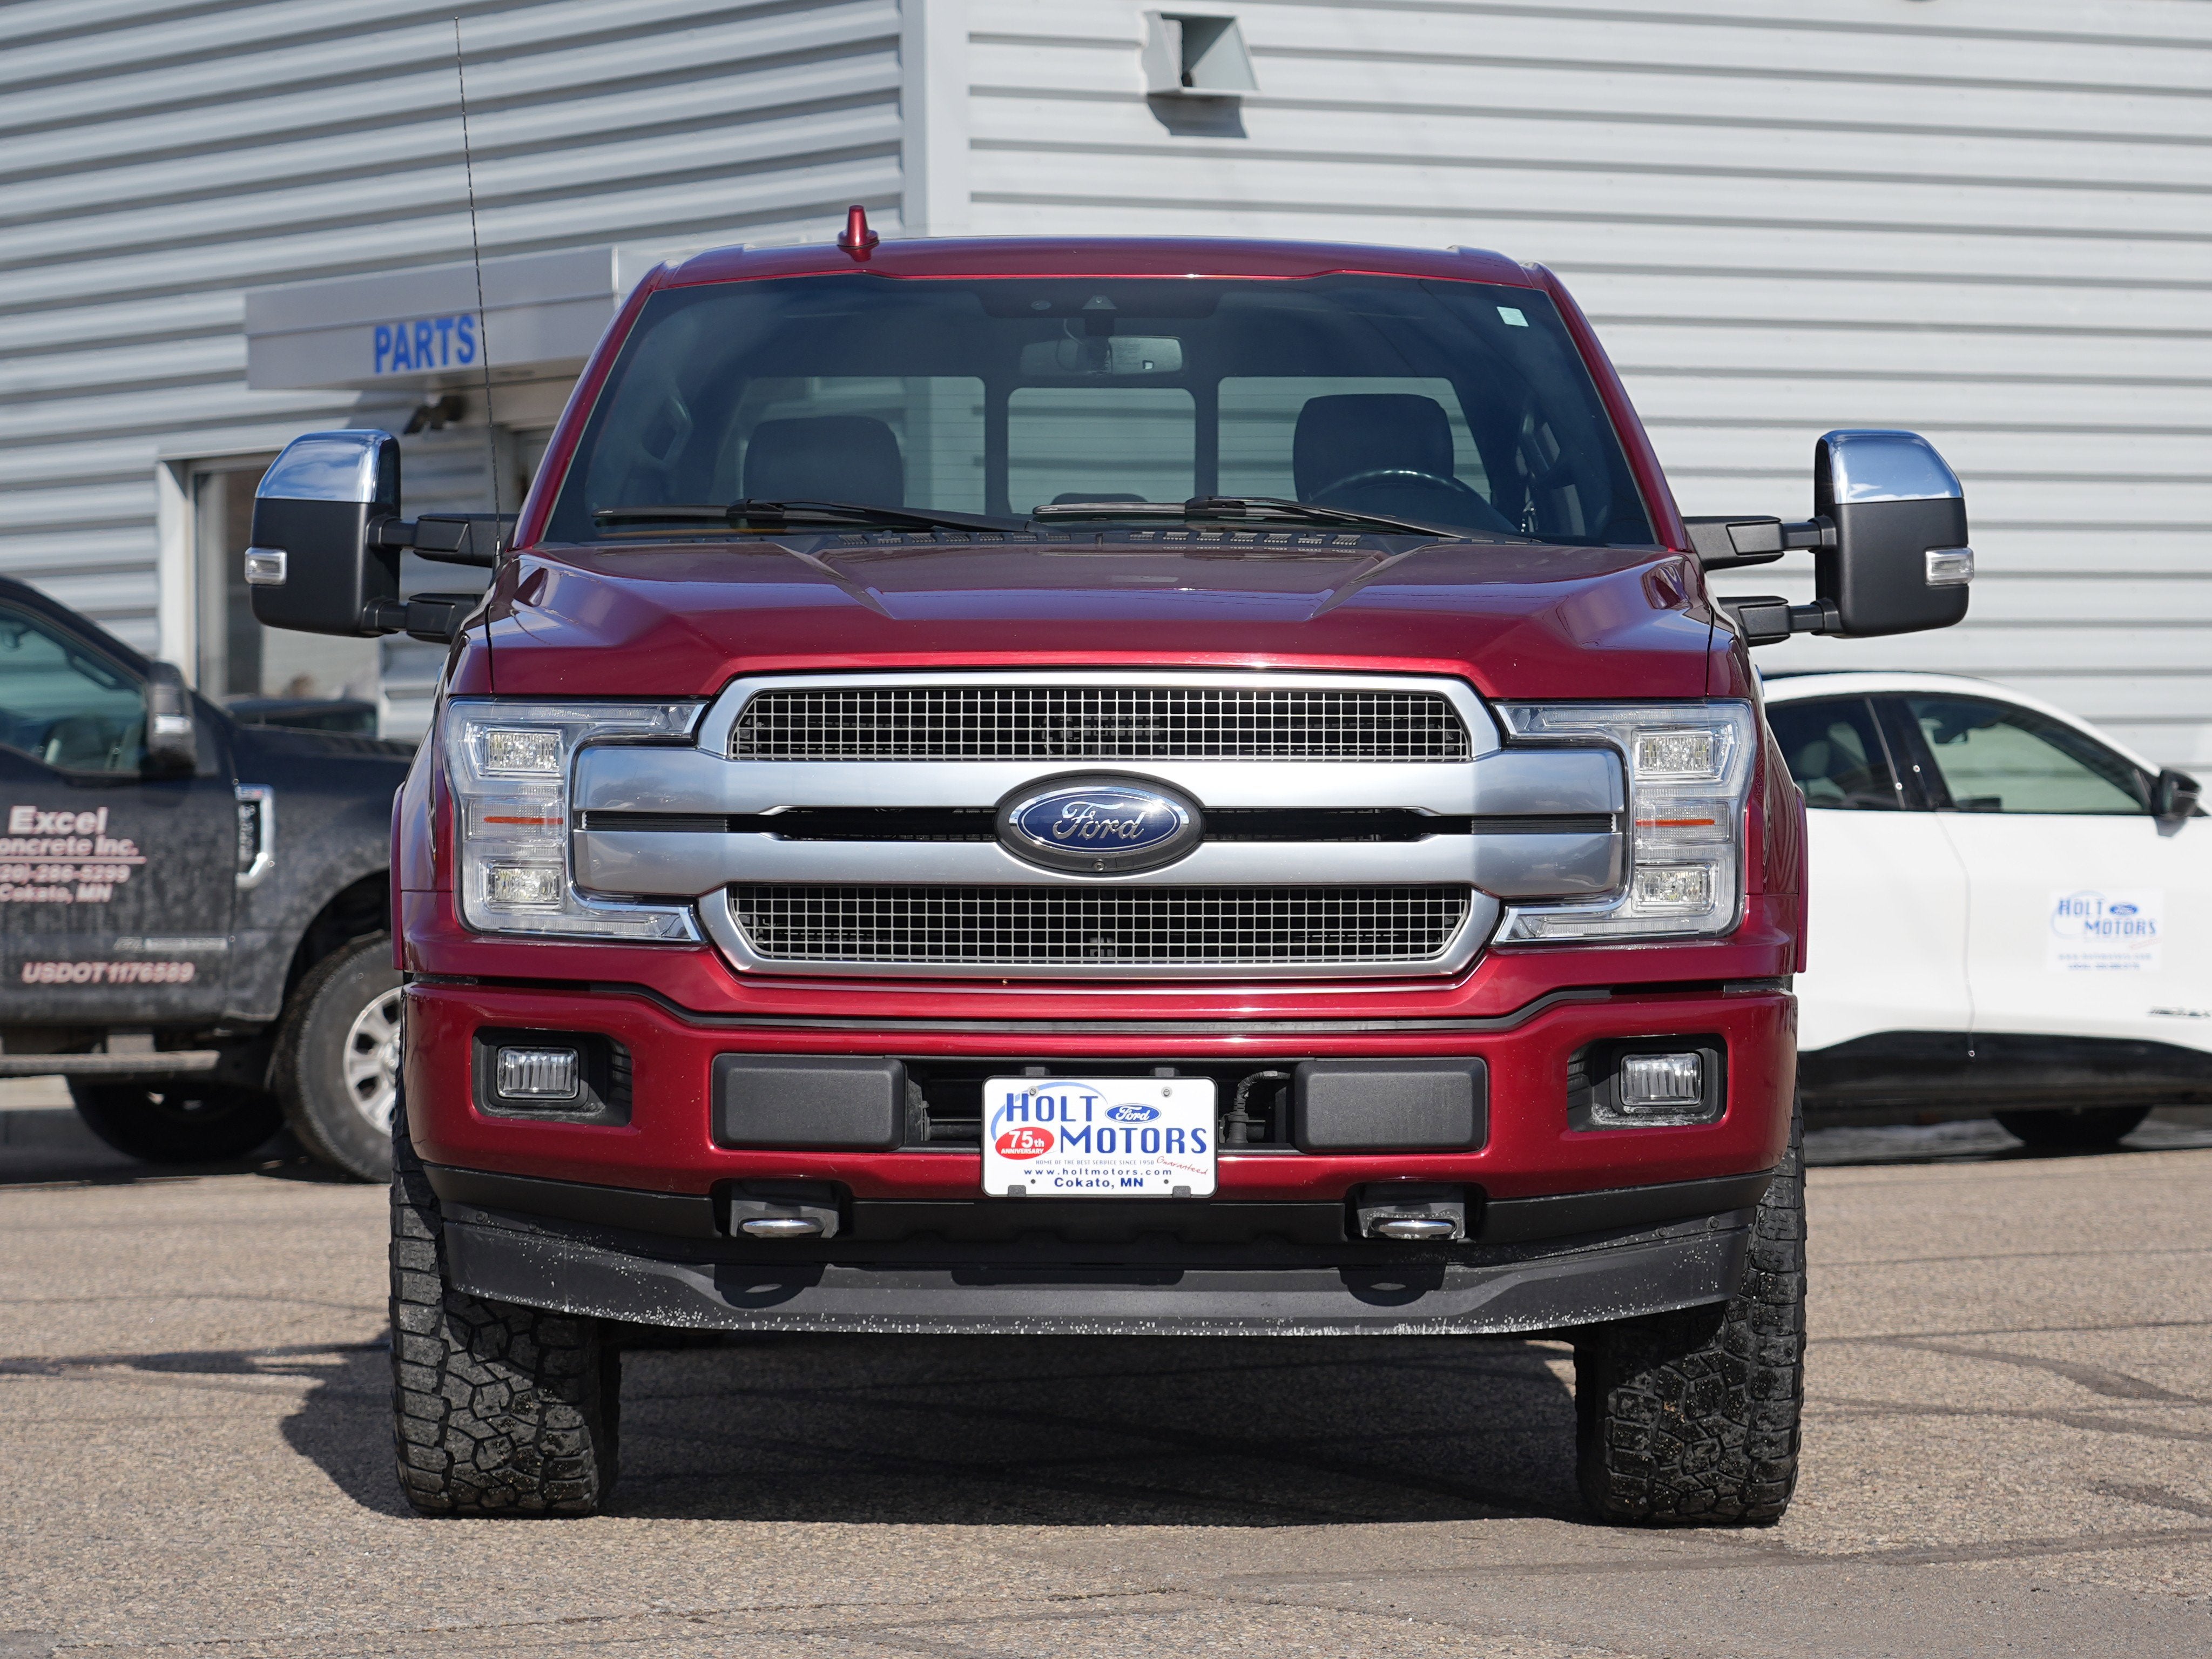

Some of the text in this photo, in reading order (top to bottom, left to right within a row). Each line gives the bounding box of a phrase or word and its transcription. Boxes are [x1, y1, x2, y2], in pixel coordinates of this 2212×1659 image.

[375, 314, 475, 373] PARTS
[8, 806, 108, 835] Excel
[1053, 801, 1146, 840] Ford
[94, 834, 139, 856] Inc.
[0, 883, 112, 904] Cokato, MN
[2058, 899, 2103, 915] HOLT
[2085, 919, 2156, 935] MOTORS
[22, 962, 107, 983] USDOT
[1006, 1093, 1098, 1122] HOLT
[1115, 1106, 1151, 1122] Ford
[1009, 1130, 1045, 1148] 75th
[1061, 1125, 1206, 1154] MOTORS
[1156, 1155, 1208, 1176] Guaranteed
[1054, 1177, 1143, 1189] Cokato, MN
